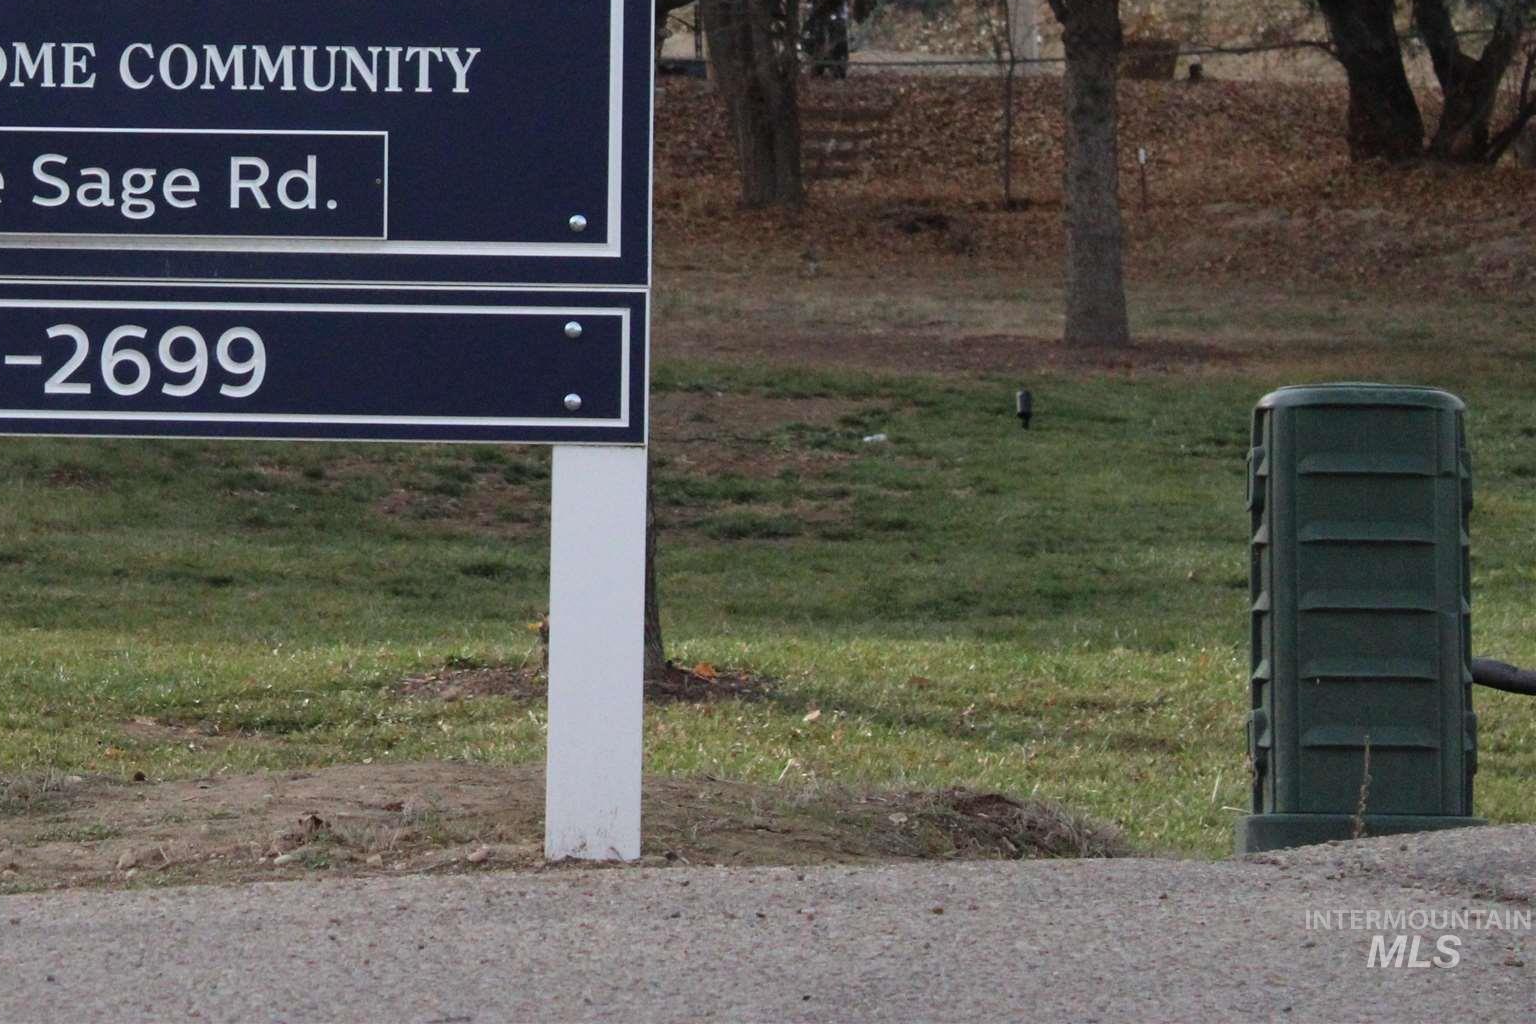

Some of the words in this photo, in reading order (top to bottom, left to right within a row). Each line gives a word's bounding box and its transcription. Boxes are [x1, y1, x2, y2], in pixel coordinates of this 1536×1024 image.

[120, 43, 480, 92] COMMUNITY
[33, 154, 199, 219] Sage
[231, 156, 337, 209] Rd.
